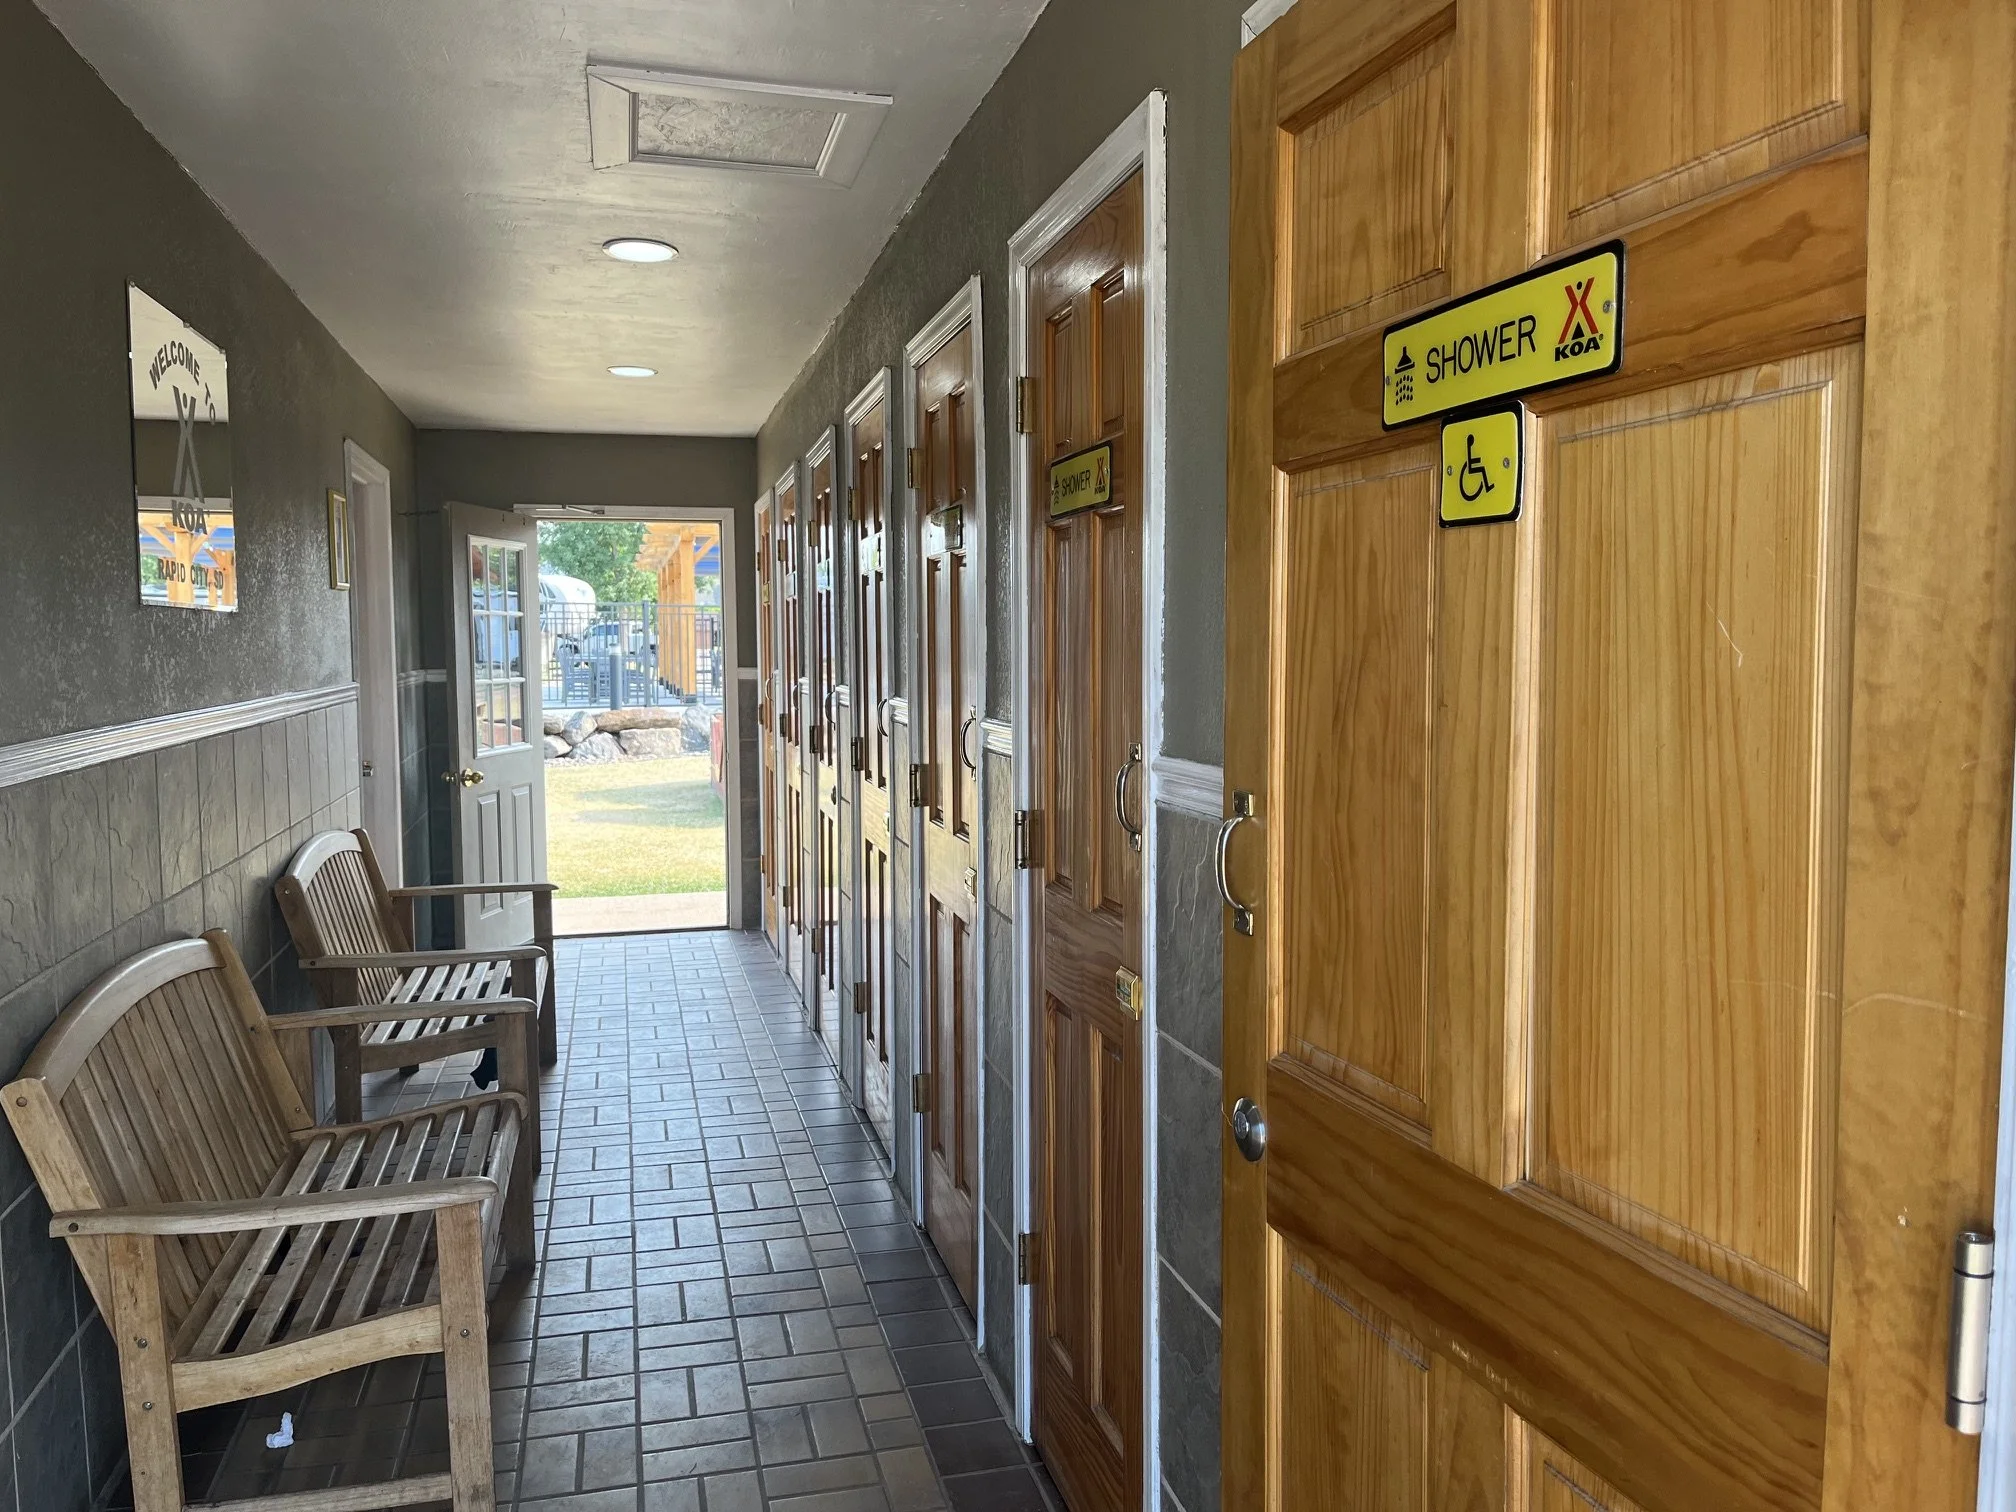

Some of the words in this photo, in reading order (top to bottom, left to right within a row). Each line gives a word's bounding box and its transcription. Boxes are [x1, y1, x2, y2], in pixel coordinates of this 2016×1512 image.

[1426, 314, 1537, 384] SHOWER
[149, 340, 200, 390] WELCOME
[204, 382, 216, 425] TO
[1061, 469, 1091, 497] SHOWER
[157, 558, 186, 583] RAPID
[213, 569, 224, 590] SD
